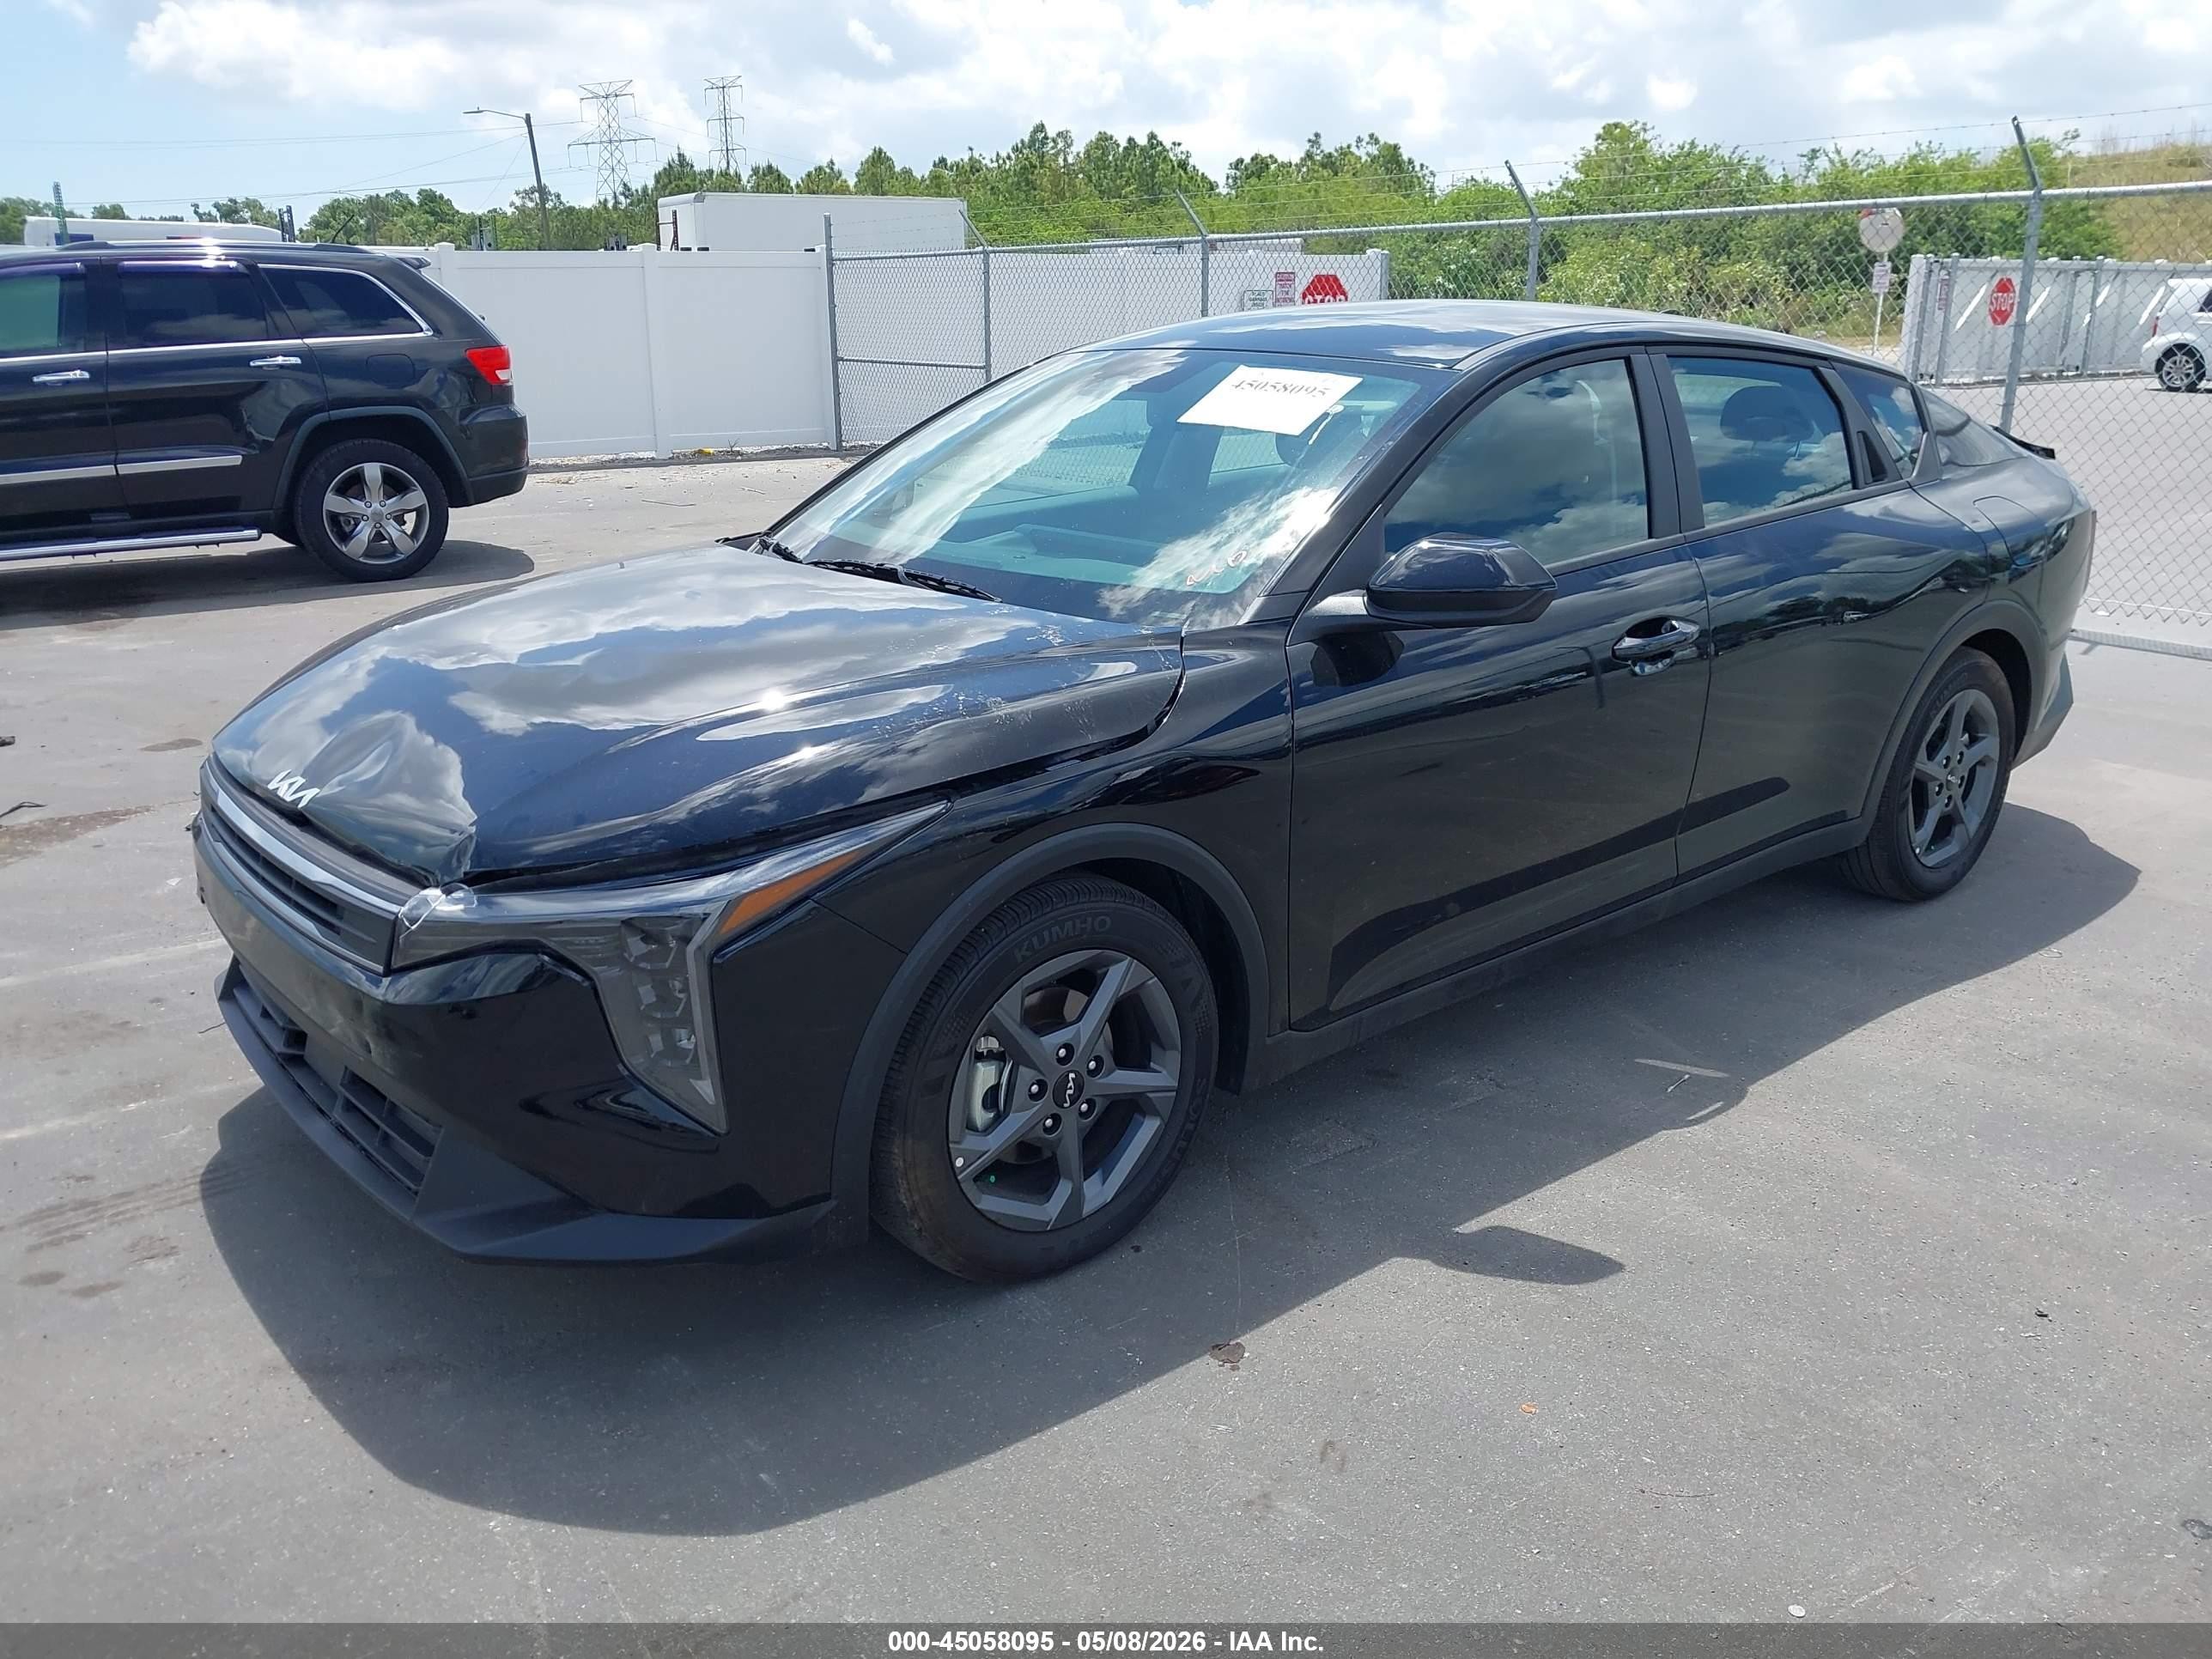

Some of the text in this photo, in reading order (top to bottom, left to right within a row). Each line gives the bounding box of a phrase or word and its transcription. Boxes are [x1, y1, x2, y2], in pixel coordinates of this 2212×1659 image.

[1989, 292, 2014, 313] STOP
[1231, 380, 1331, 398] 45058095
[1014, 916, 1111, 963] KUMHO
